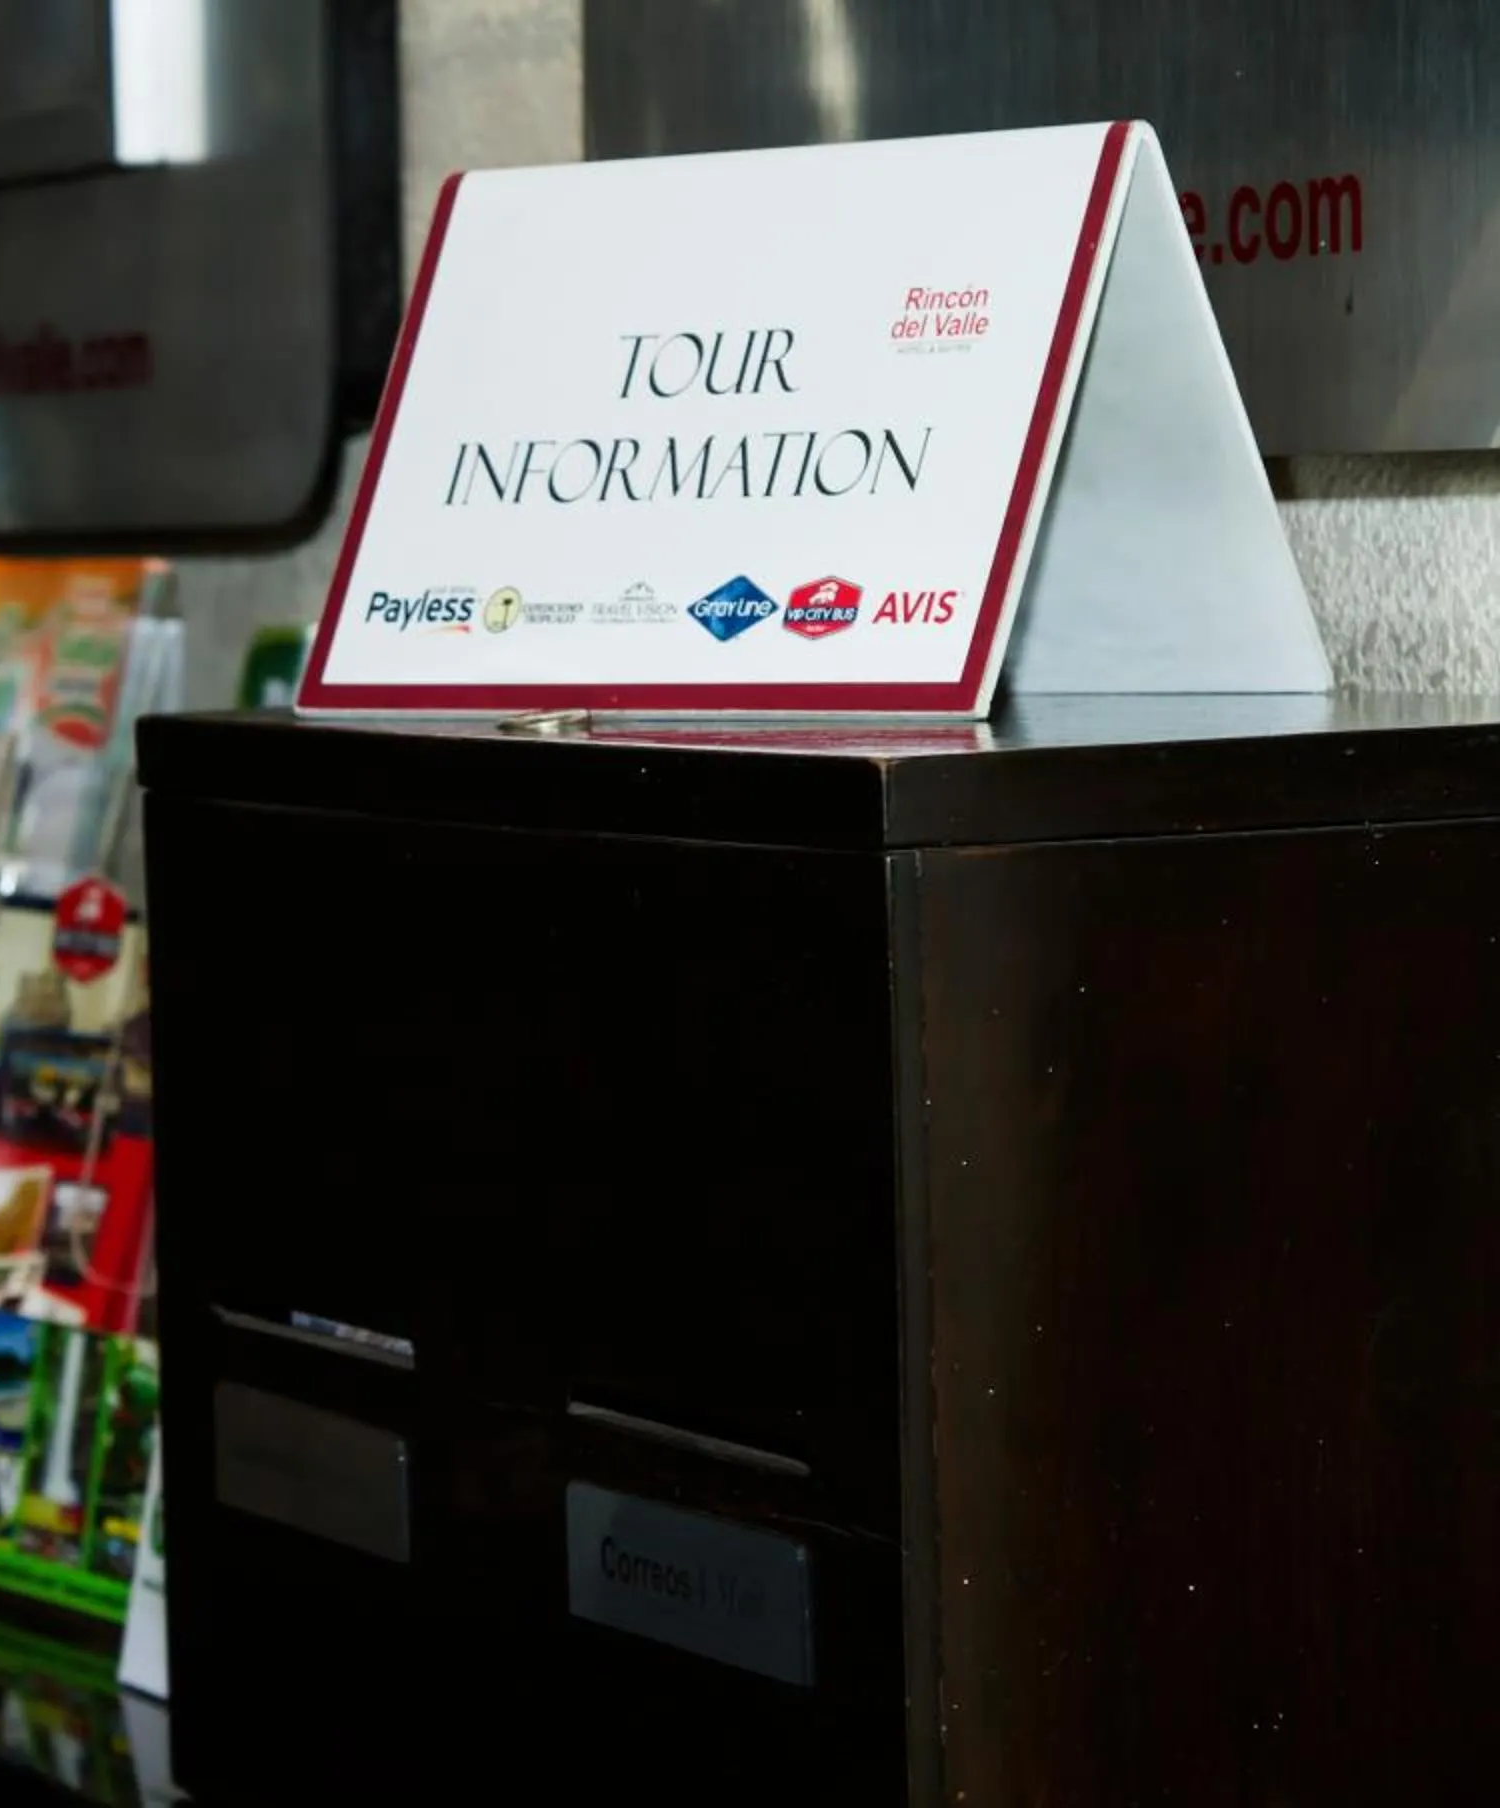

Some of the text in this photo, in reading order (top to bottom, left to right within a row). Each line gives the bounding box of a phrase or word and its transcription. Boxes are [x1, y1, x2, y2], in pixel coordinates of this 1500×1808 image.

[905, 283, 990, 311] Rincón
[891, 311, 990, 339] del Valle
[619, 327, 801, 399] TOUR
[444, 426, 933, 506] INFORMATION
[365, 589, 475, 632] Payless
[872, 591, 957, 624] AVIS
[601, 1535, 693, 1602] Correos
